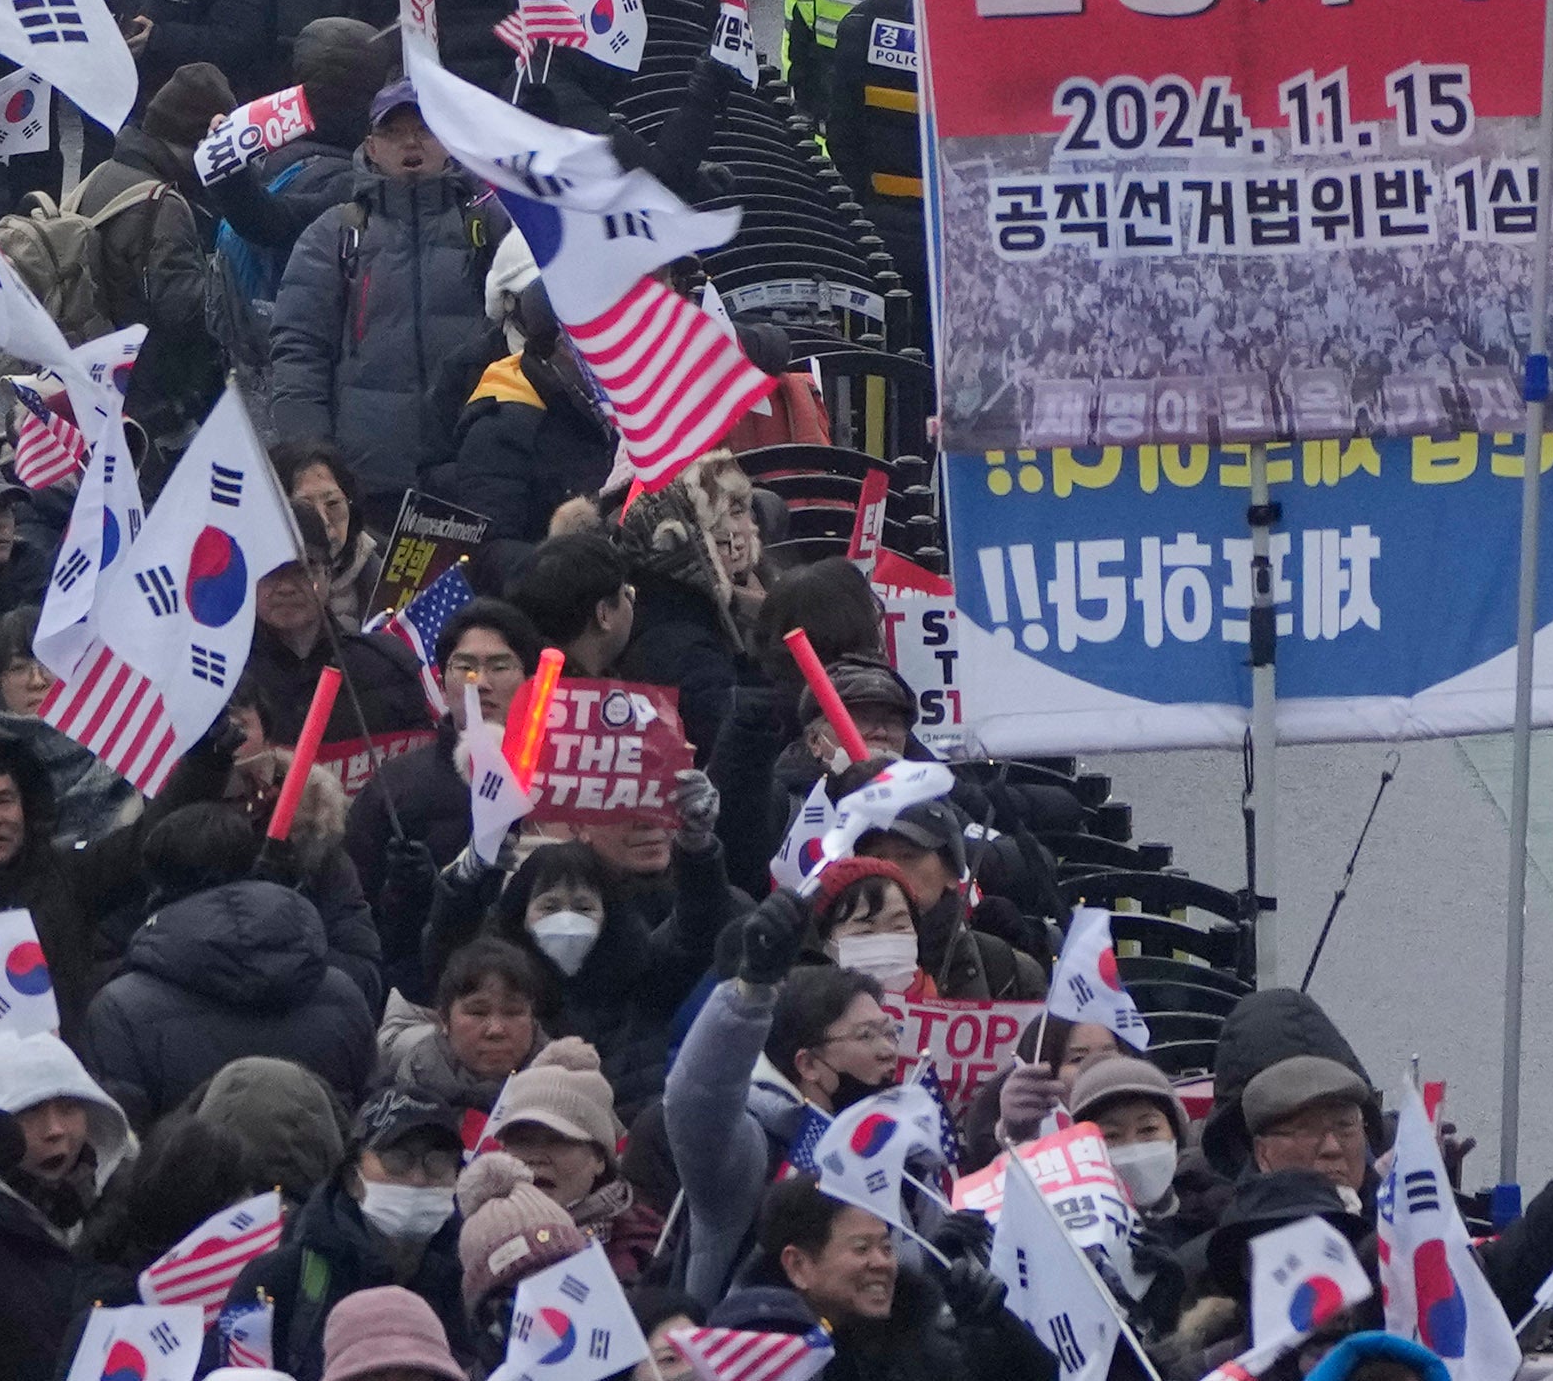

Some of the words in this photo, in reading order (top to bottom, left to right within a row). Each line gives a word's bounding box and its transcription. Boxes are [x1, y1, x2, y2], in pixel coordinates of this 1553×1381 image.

[994, 168, 1431, 252] 공직선거법위반
[1453, 165, 1541, 236] 1심
[550, 734, 643, 774] THE
